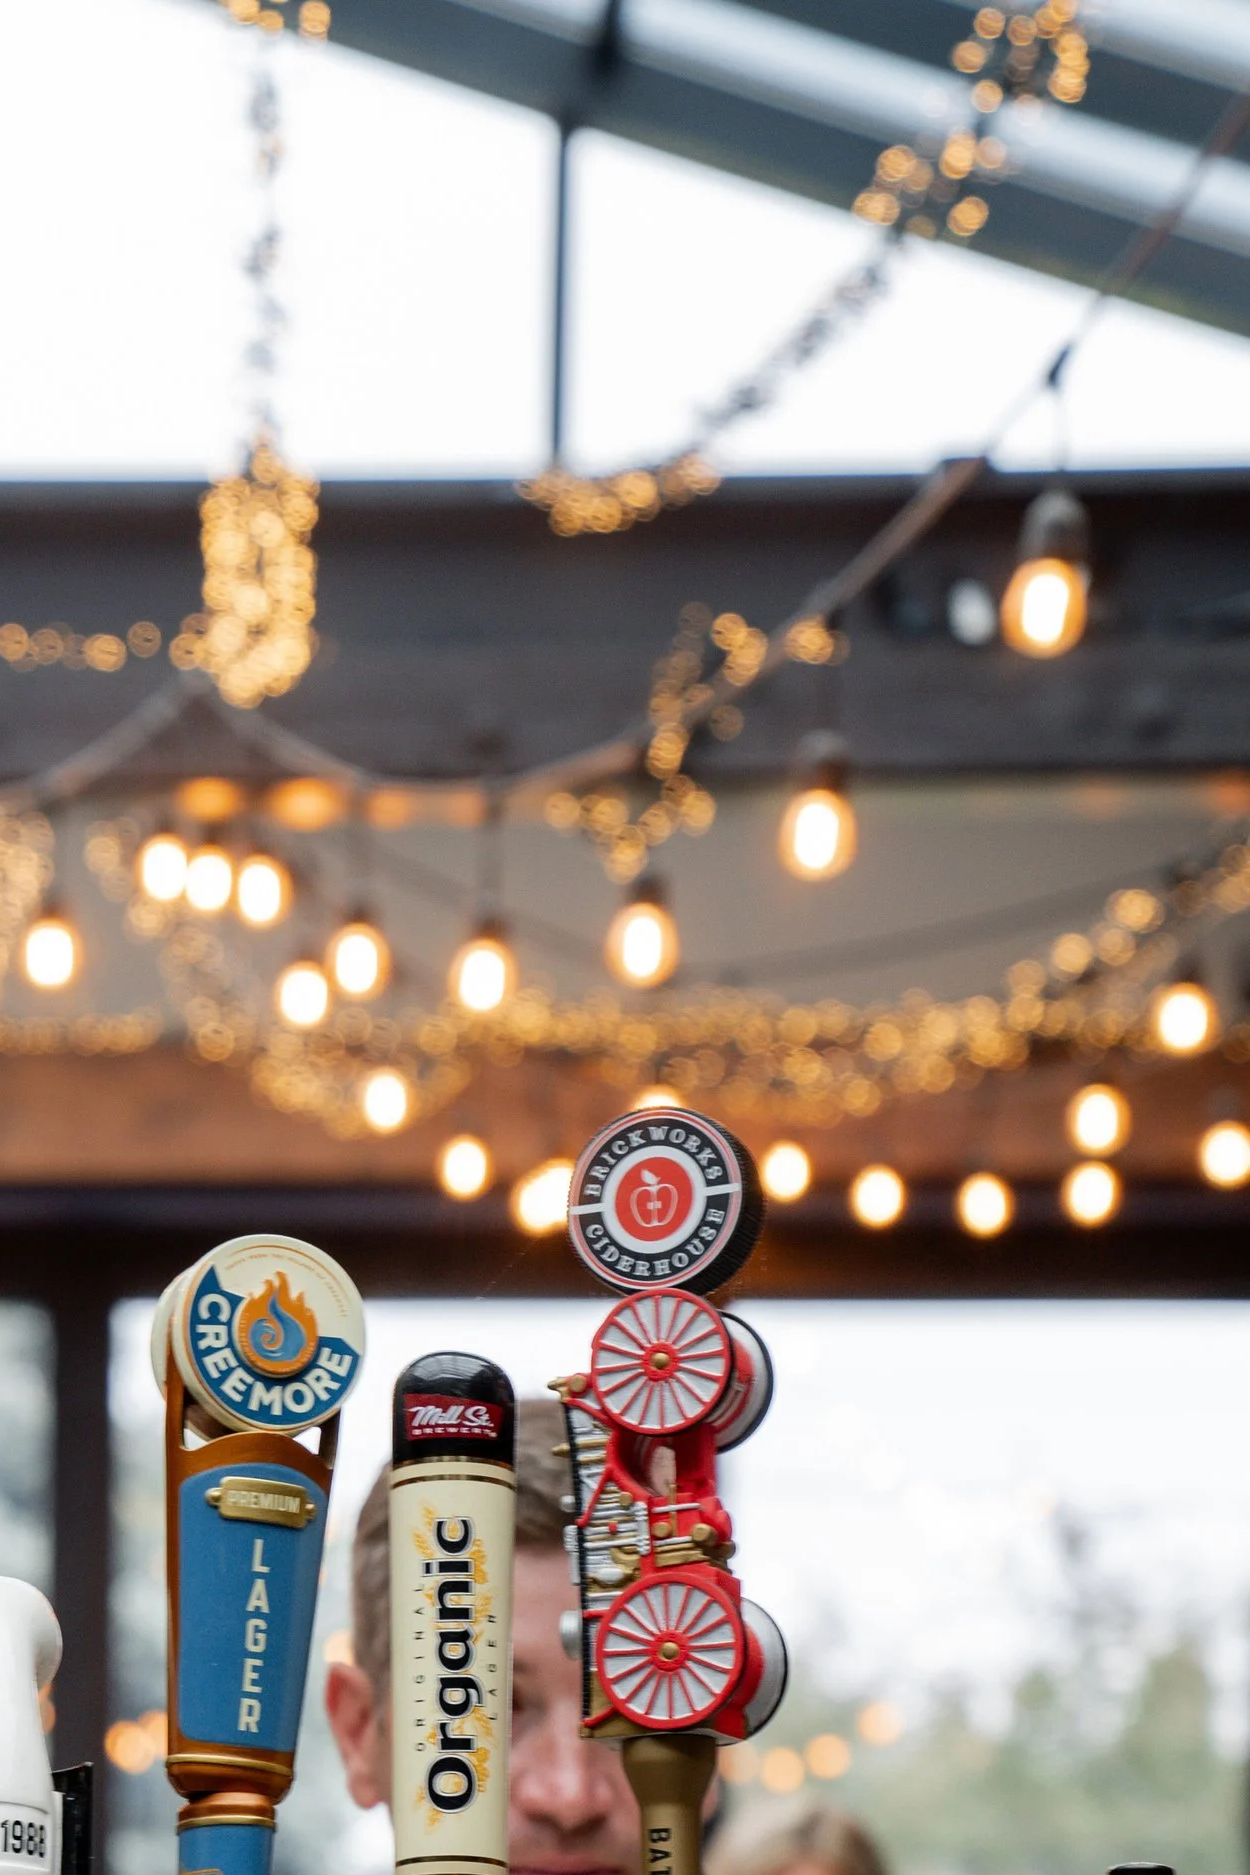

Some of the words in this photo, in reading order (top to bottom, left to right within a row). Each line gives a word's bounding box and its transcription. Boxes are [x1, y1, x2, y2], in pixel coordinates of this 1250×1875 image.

[583, 1126, 723, 1197] BRICKWORKS
[586, 1208, 725, 1277] CIDERHOUSE
[195, 1293, 353, 1416] CREEMORE
[225, 1489, 301, 1514] PREMIUM
[237, 1538, 271, 1734] LAGER
[413, 1584, 426, 1752] ORIGINAL
[421, 1516, 486, 1814] Organic
[487, 1613, 499, 1722] LAGER
[0, 1819, 47, 1859] 1988
